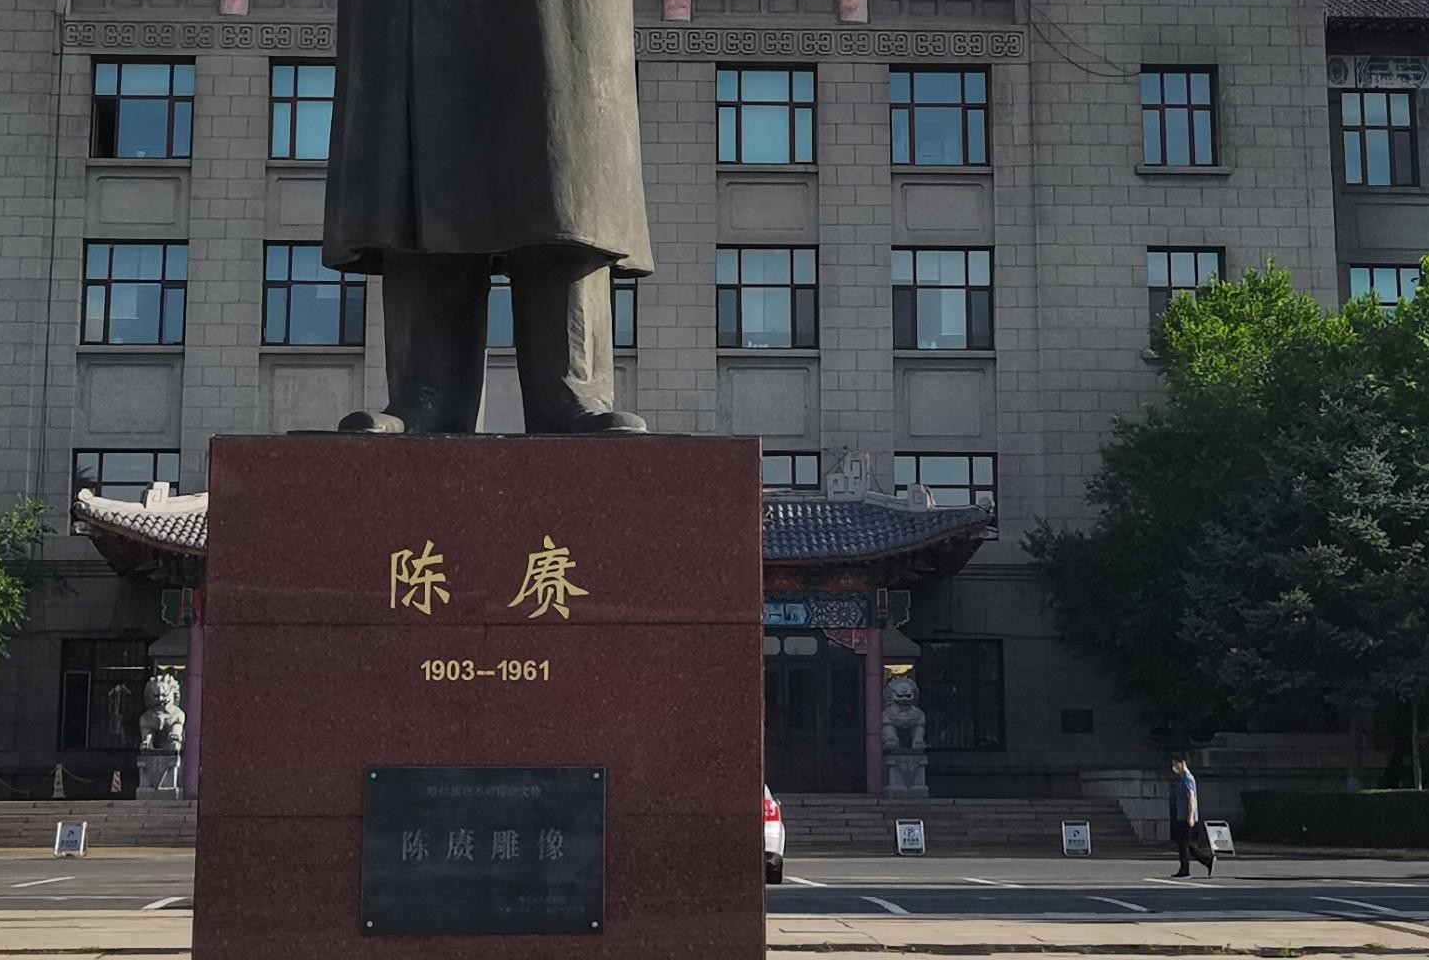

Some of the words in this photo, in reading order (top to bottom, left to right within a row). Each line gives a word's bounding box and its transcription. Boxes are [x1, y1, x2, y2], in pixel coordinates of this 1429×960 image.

[390, 535, 589, 619] 陈赓
[401, 828, 564, 861] 陈赓雕像
